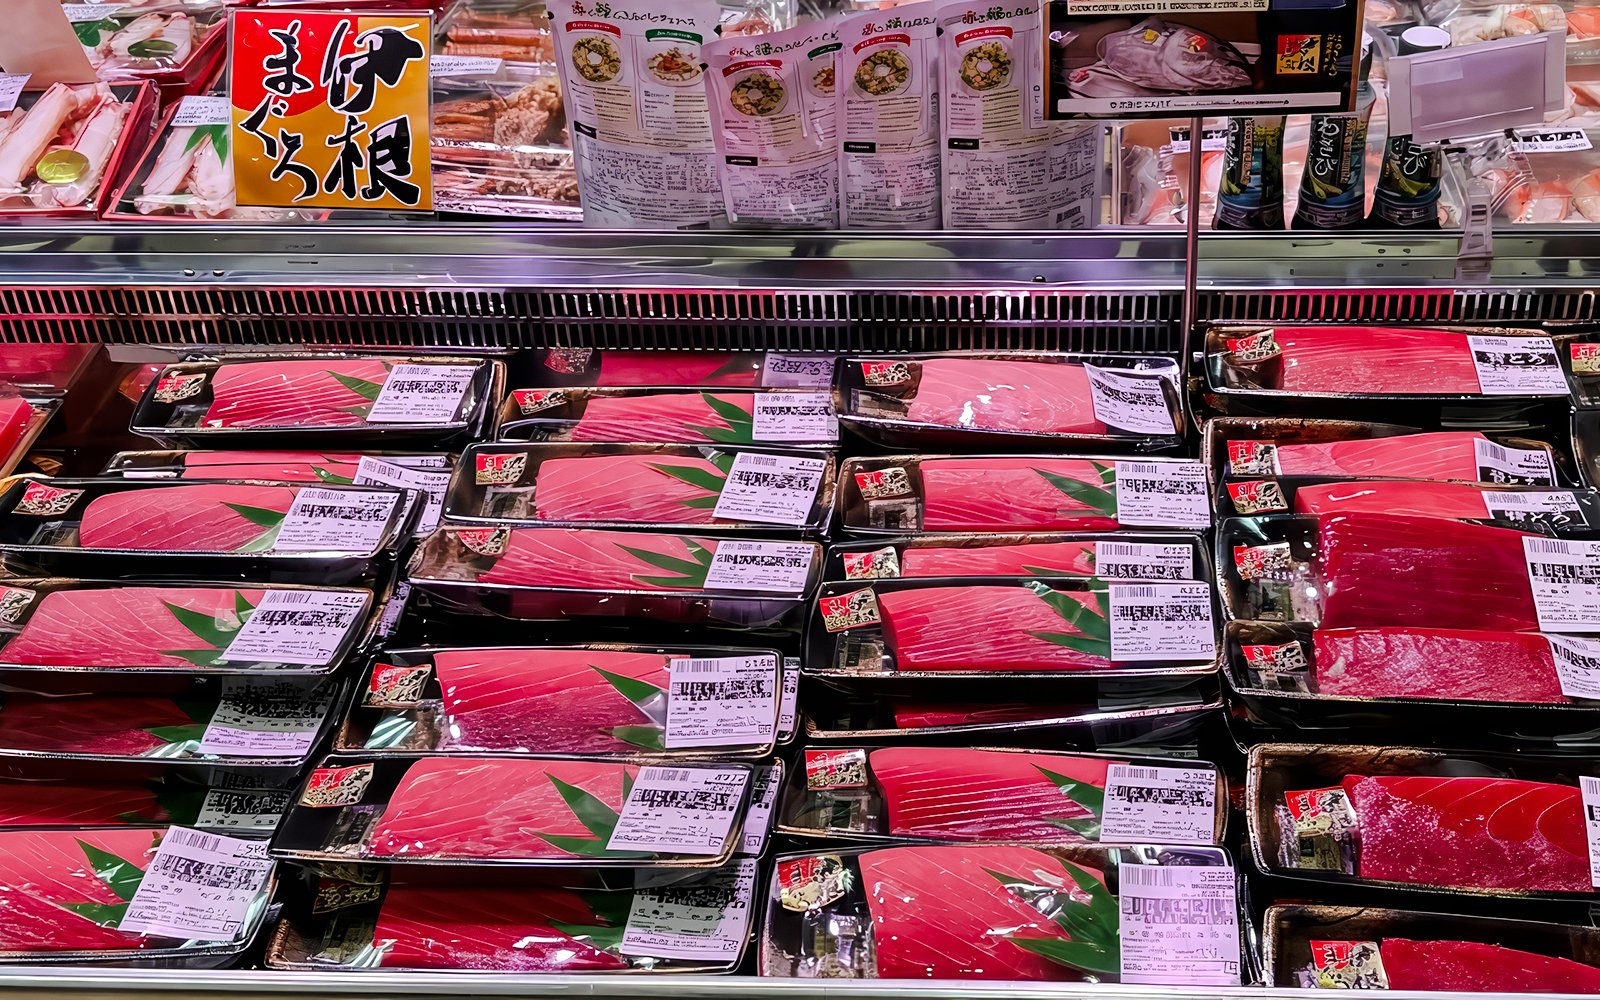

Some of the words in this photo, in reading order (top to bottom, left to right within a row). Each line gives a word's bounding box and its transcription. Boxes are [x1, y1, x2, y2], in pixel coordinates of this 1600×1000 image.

[238, 19, 320, 202] まぐろ
[320, 19, 425, 206] 伊根
